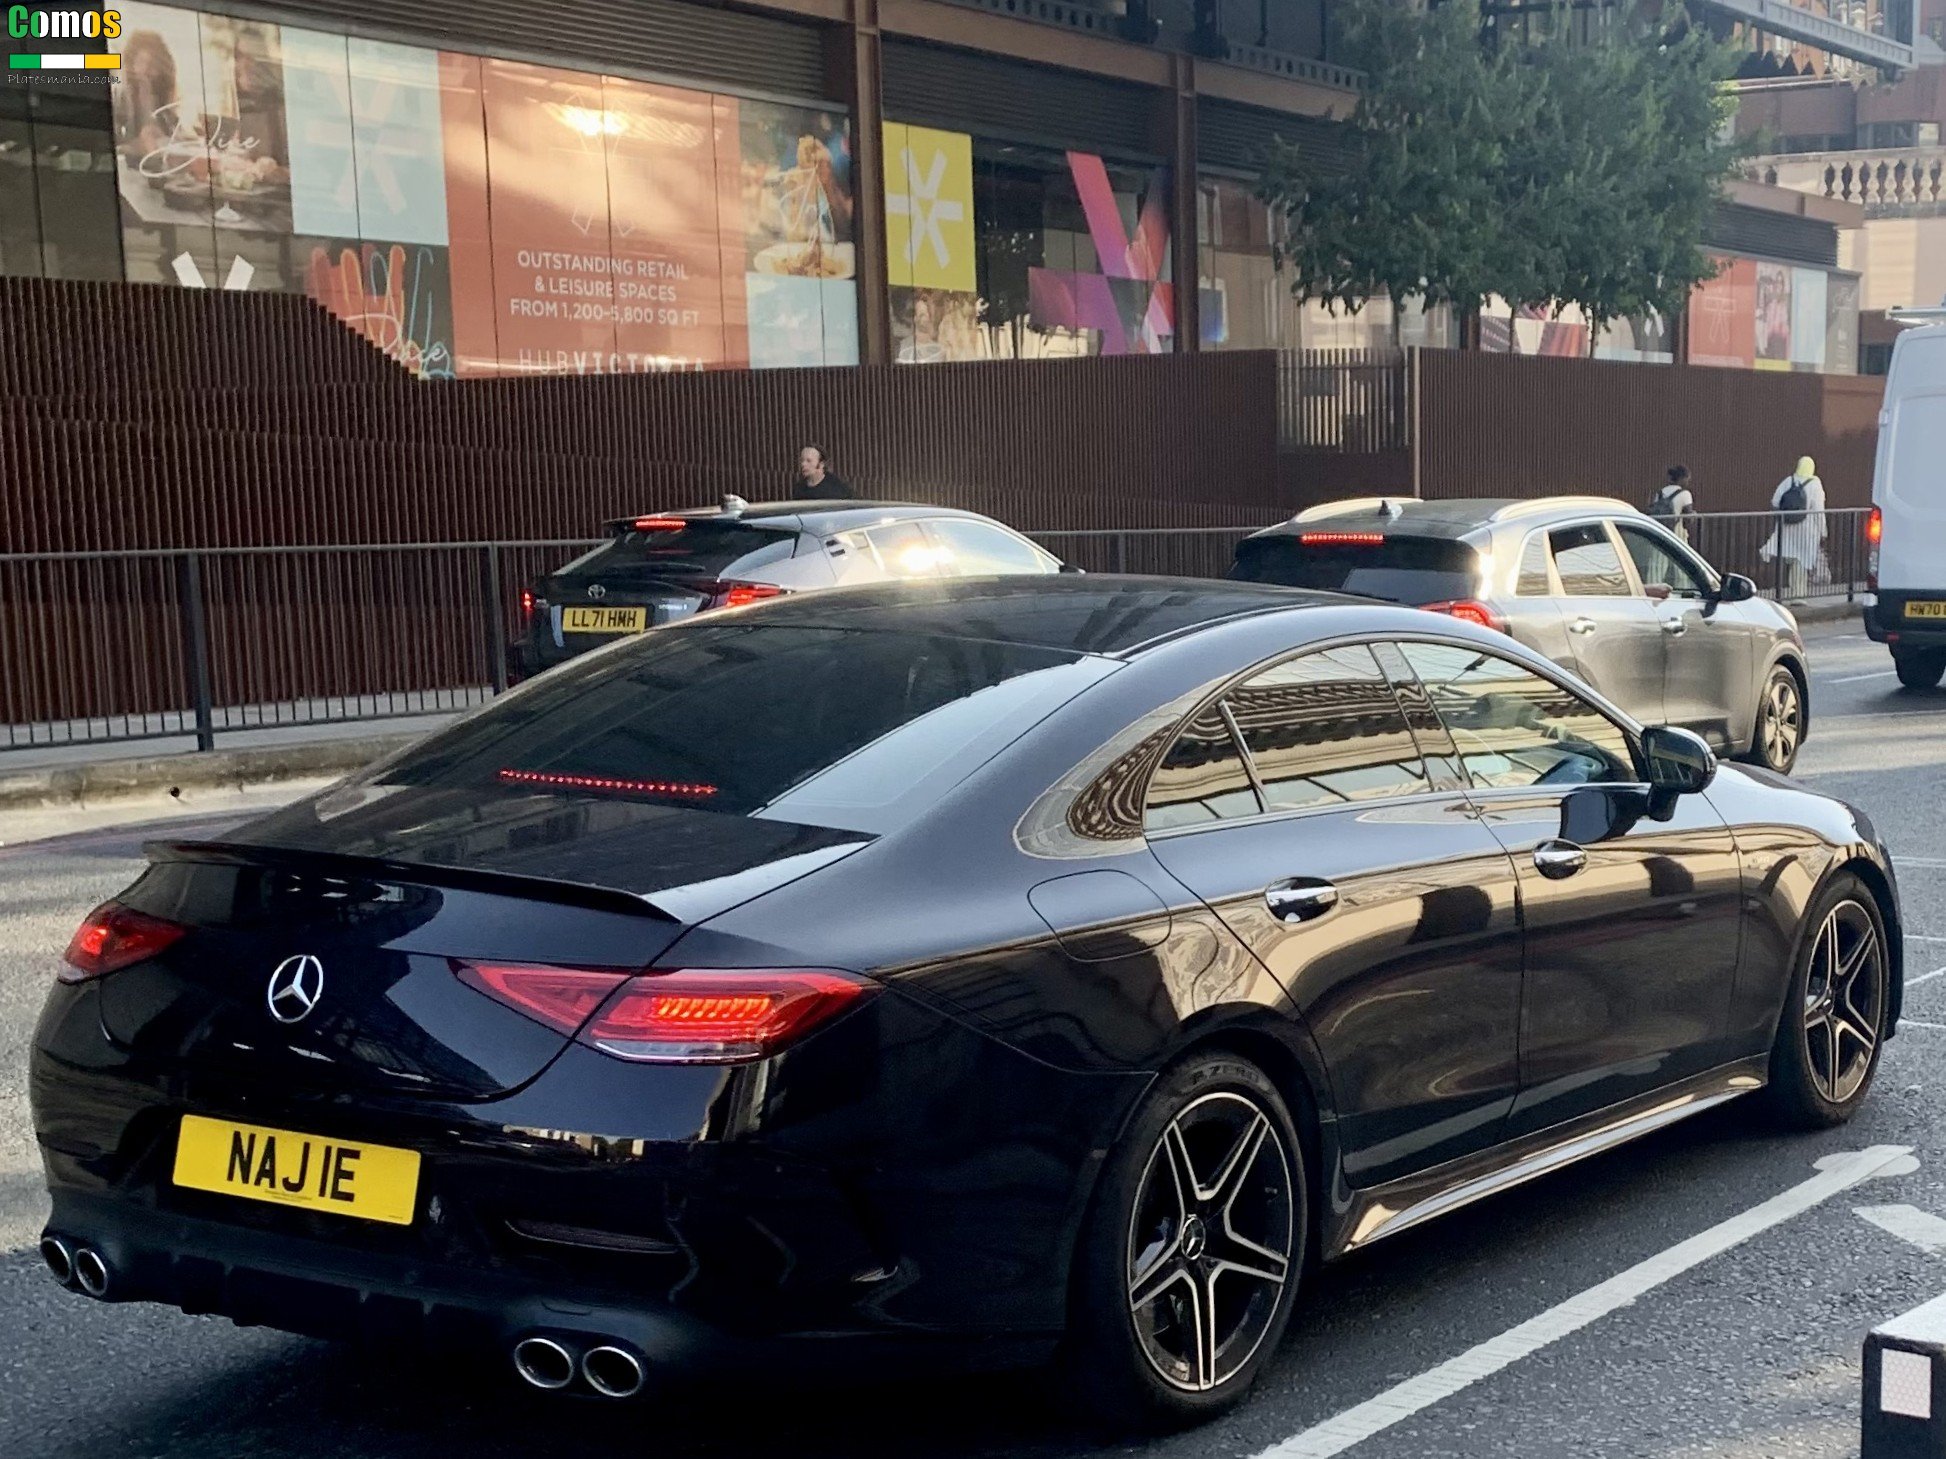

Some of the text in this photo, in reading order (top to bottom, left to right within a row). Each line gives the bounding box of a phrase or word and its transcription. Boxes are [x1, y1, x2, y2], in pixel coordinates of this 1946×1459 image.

[517, 249, 689, 280] OUTSTANDING RETAIL
[534, 275, 678, 302] & LEISURE SPACES
[510, 298, 558, 318] FROM
[657, 309, 678, 325] SQ
[682, 310, 700, 326] FT
[571, 609, 605, 628] LL71
